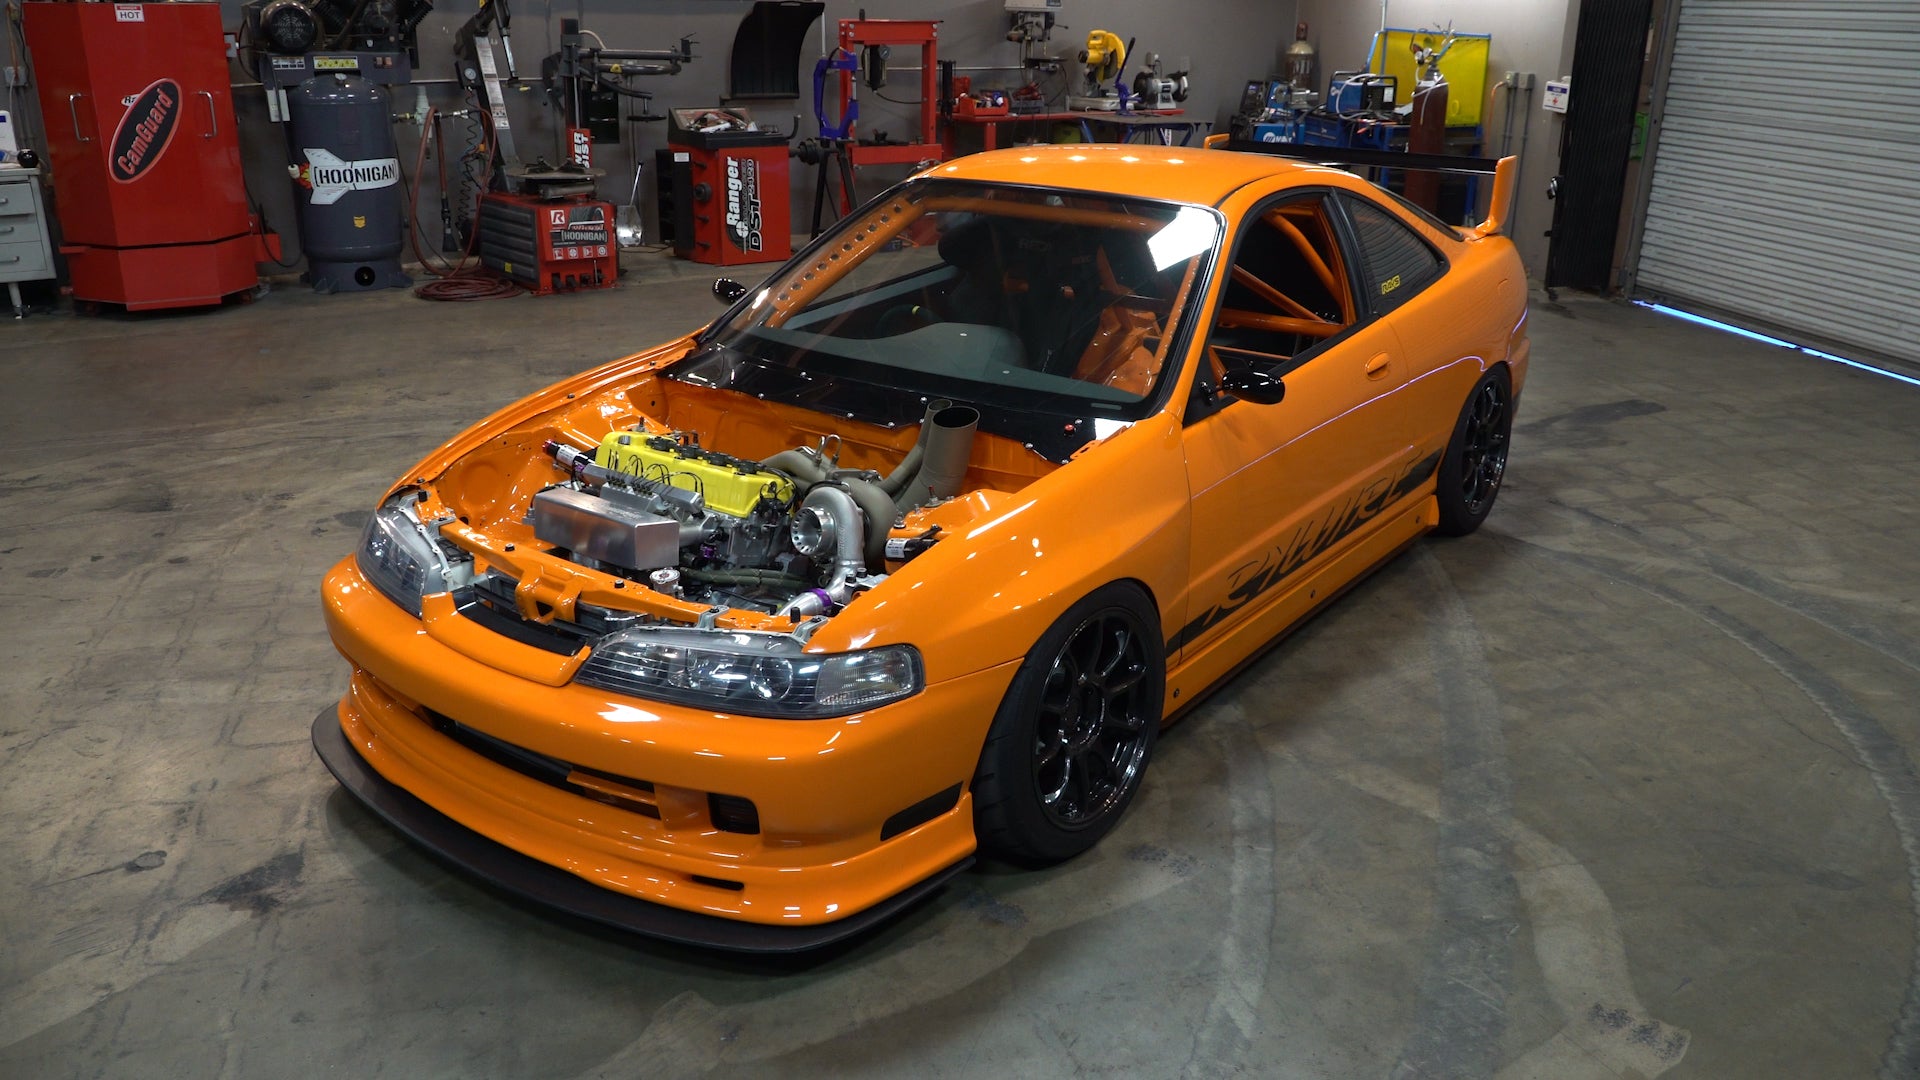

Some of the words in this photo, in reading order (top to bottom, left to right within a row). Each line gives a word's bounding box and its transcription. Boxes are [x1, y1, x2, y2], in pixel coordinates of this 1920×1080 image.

[120, 11, 140, 19] HOT
[117, 87, 173, 175] CamGuard
[726, 156, 743, 226] Ranger
